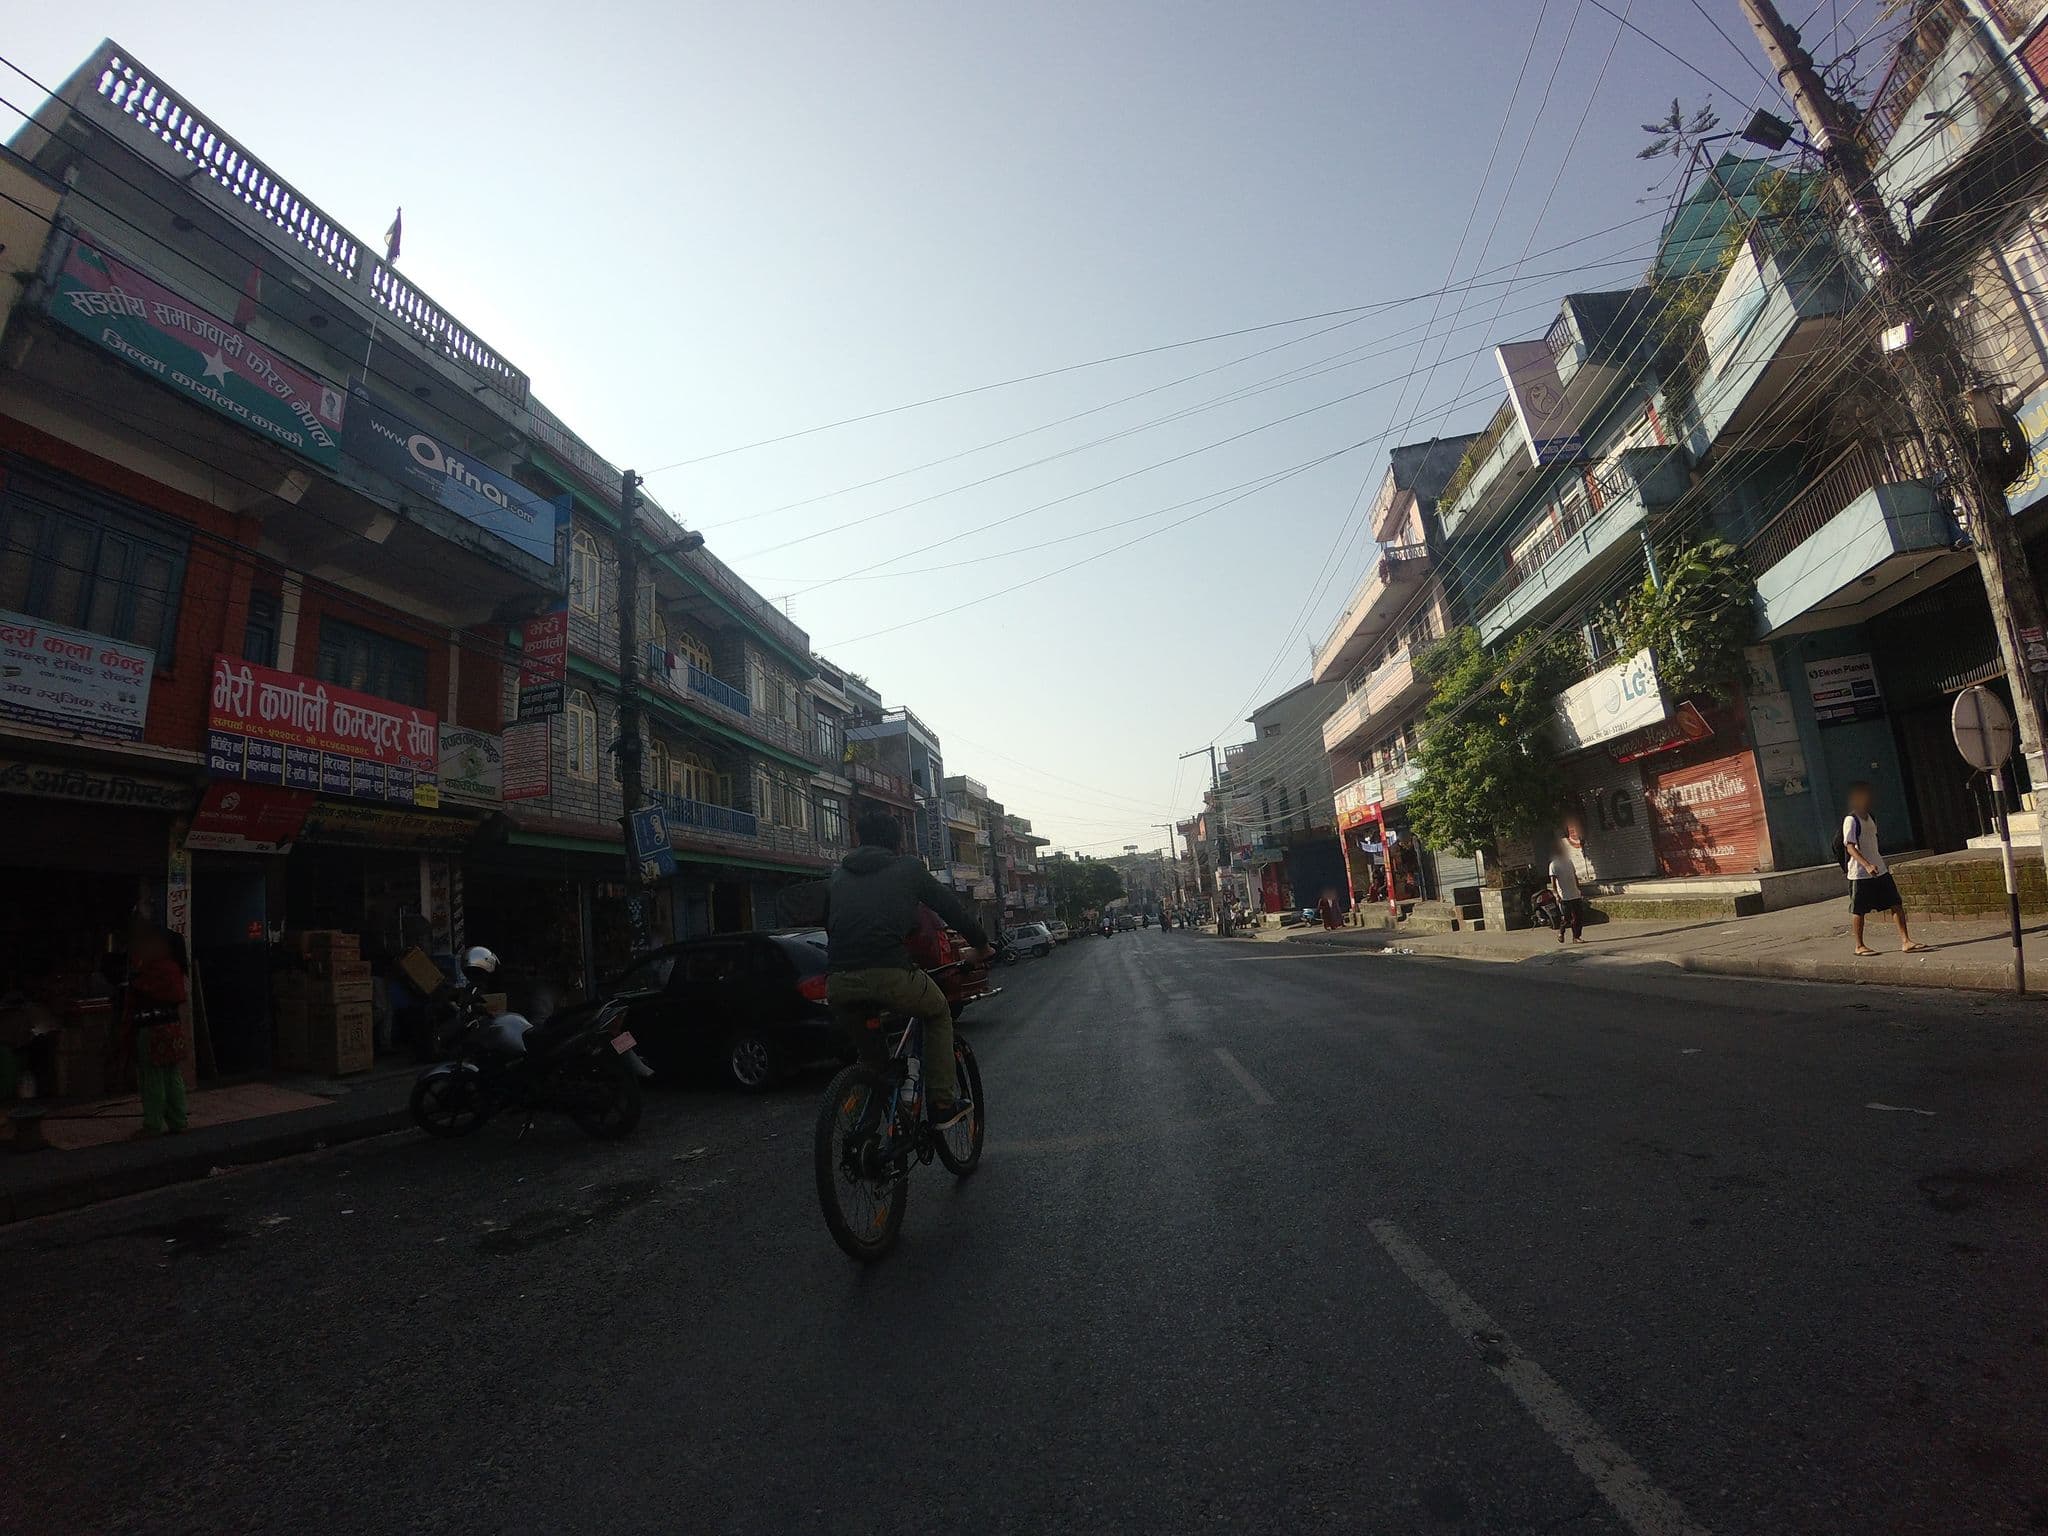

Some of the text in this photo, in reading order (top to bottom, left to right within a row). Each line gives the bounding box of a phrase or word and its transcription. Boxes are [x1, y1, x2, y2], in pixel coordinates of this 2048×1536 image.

[102, 328, 166, 374] जिल्ला
[151, 301, 244, 357] समाजवादी
[246, 350, 295, 400] फोरम
[291, 398, 335, 448] नेपाल
[43, 636, 93, 661] कला
[1622, 671, 1647, 701] LG
[213, 659, 255, 718] भेरी
[259, 681, 329, 734] कर्णाली
[407, 711, 434, 757] सेवा
[211, 755, 241, 772] बिल
[1600, 789, 1635, 832] LG
